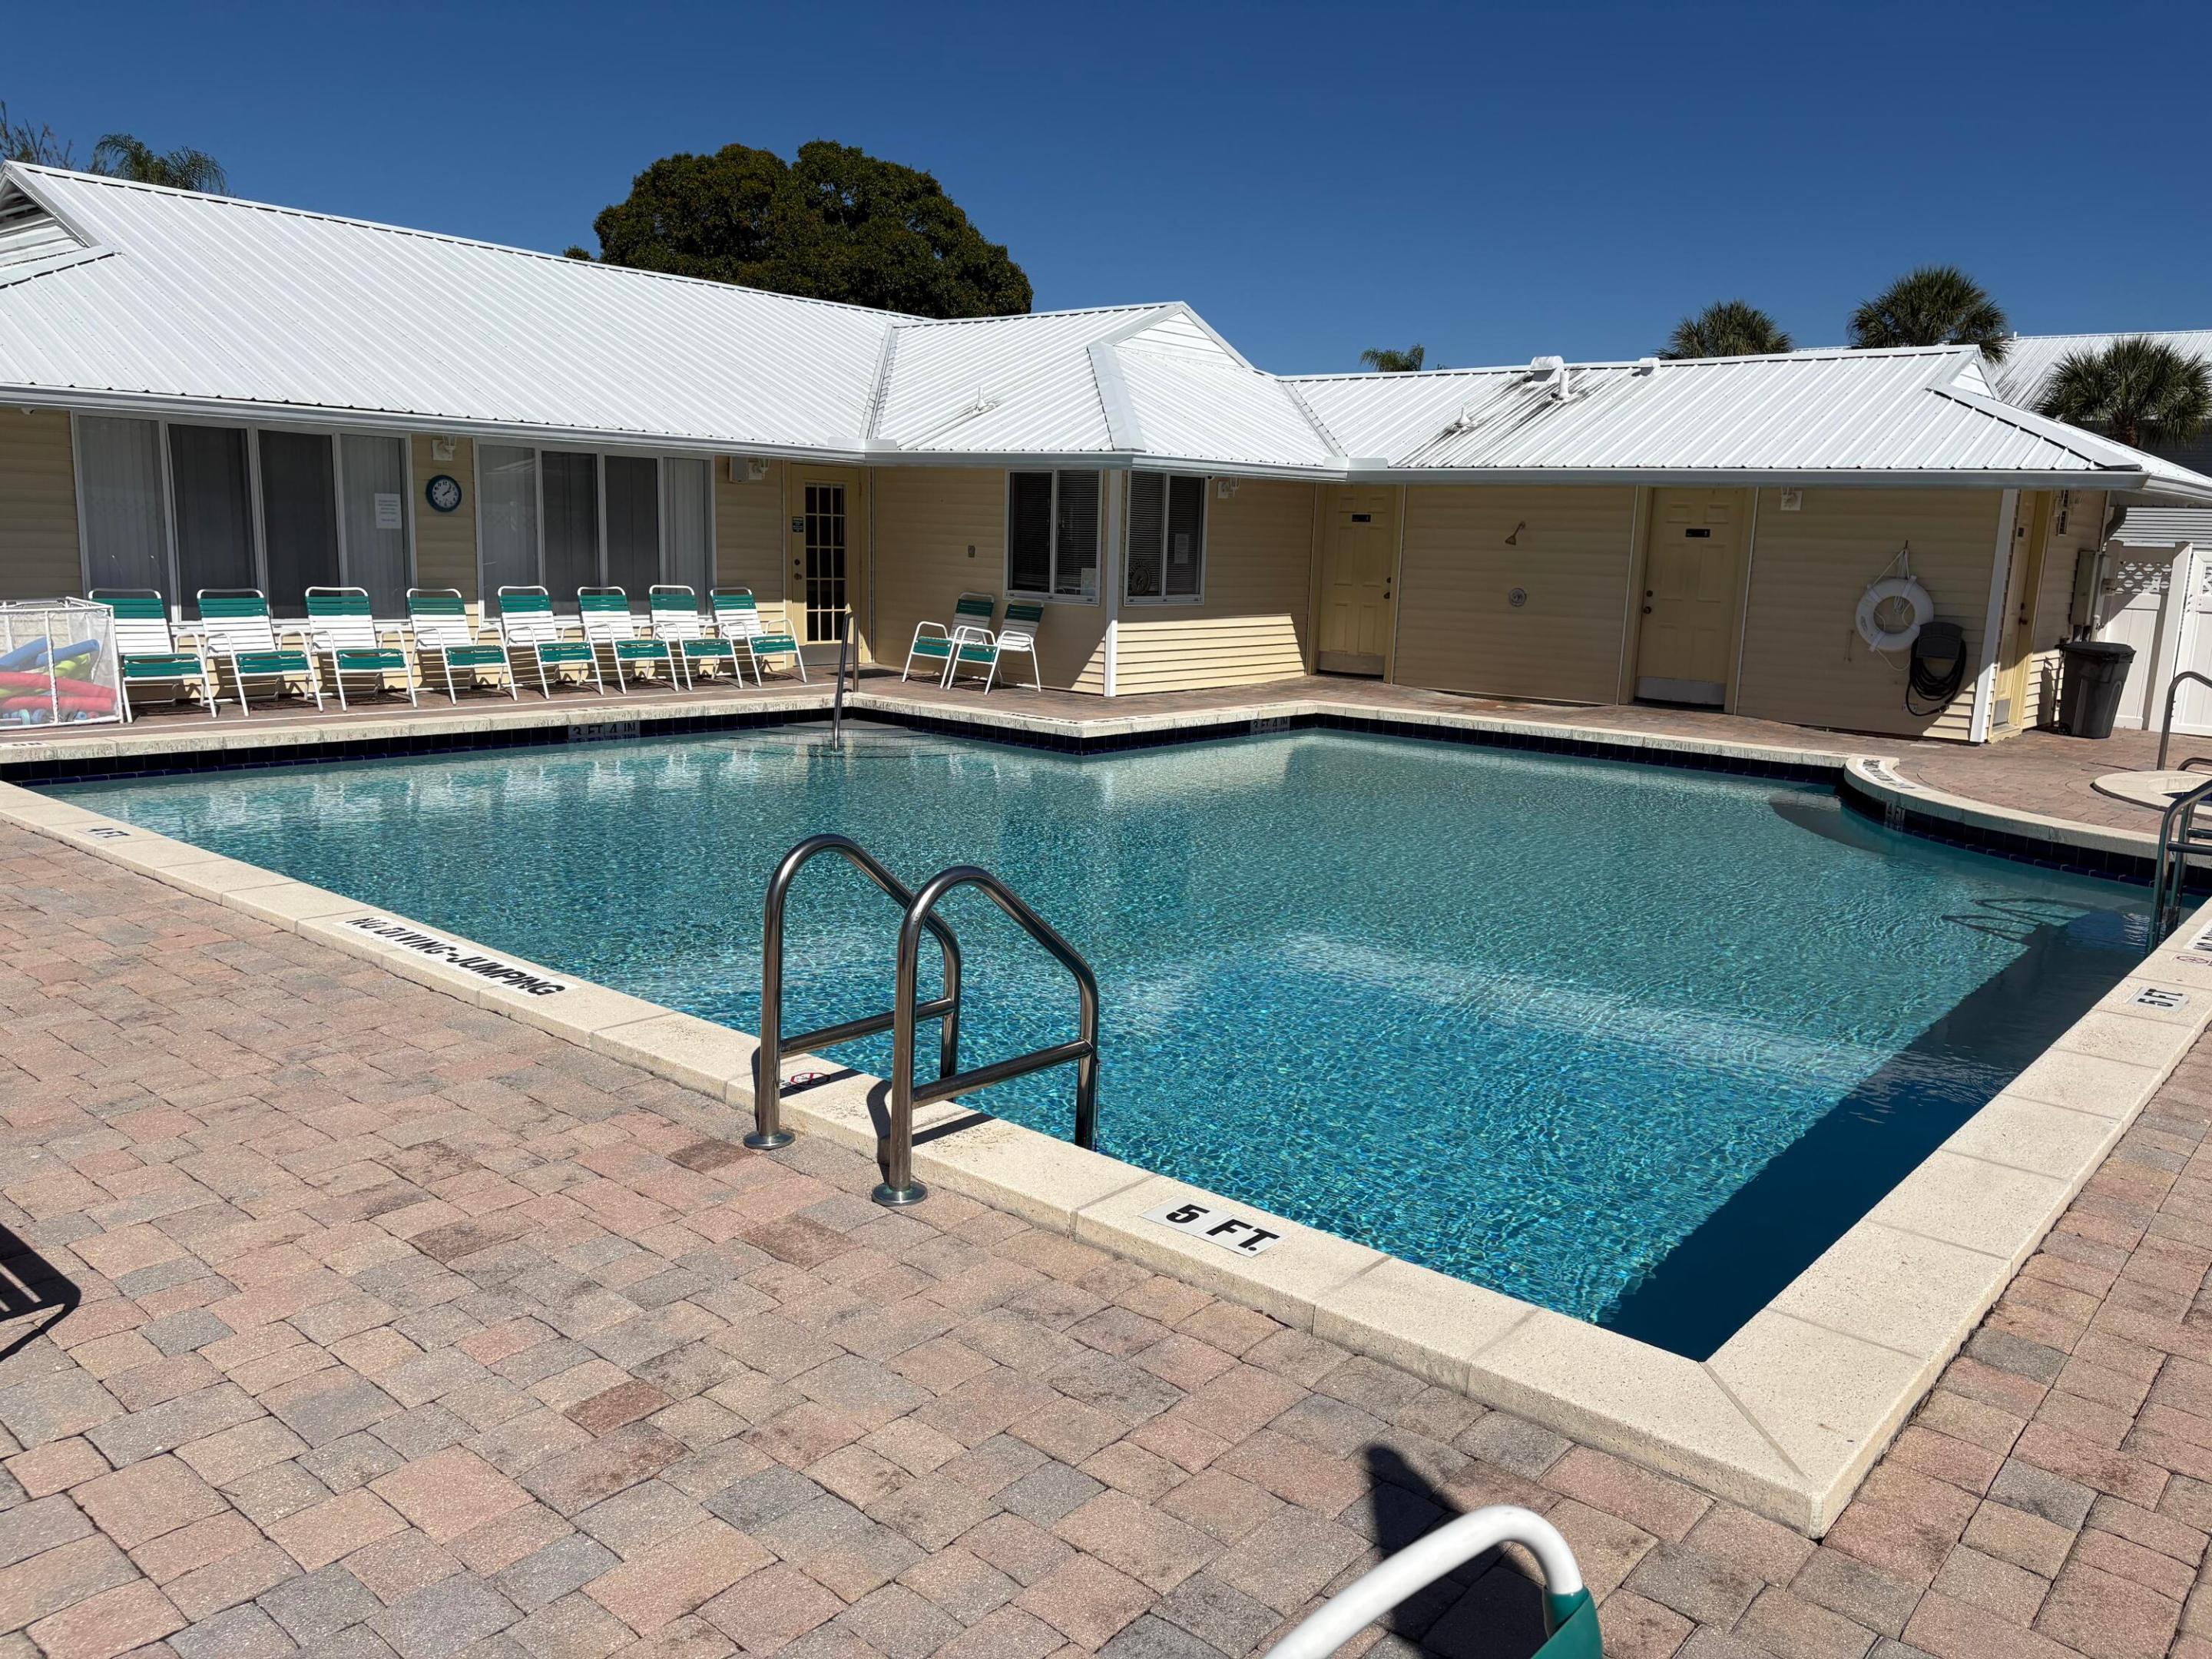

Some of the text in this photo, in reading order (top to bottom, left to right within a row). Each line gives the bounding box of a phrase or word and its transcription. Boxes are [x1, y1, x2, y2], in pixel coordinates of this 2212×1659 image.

[588, 724, 603, 734] FT
[624, 722, 636, 732] IN
[345, 916, 382, 929] NO
[2137, 998, 2174, 1007] 5
[1166, 1204, 1280, 1251] 5 FT.
